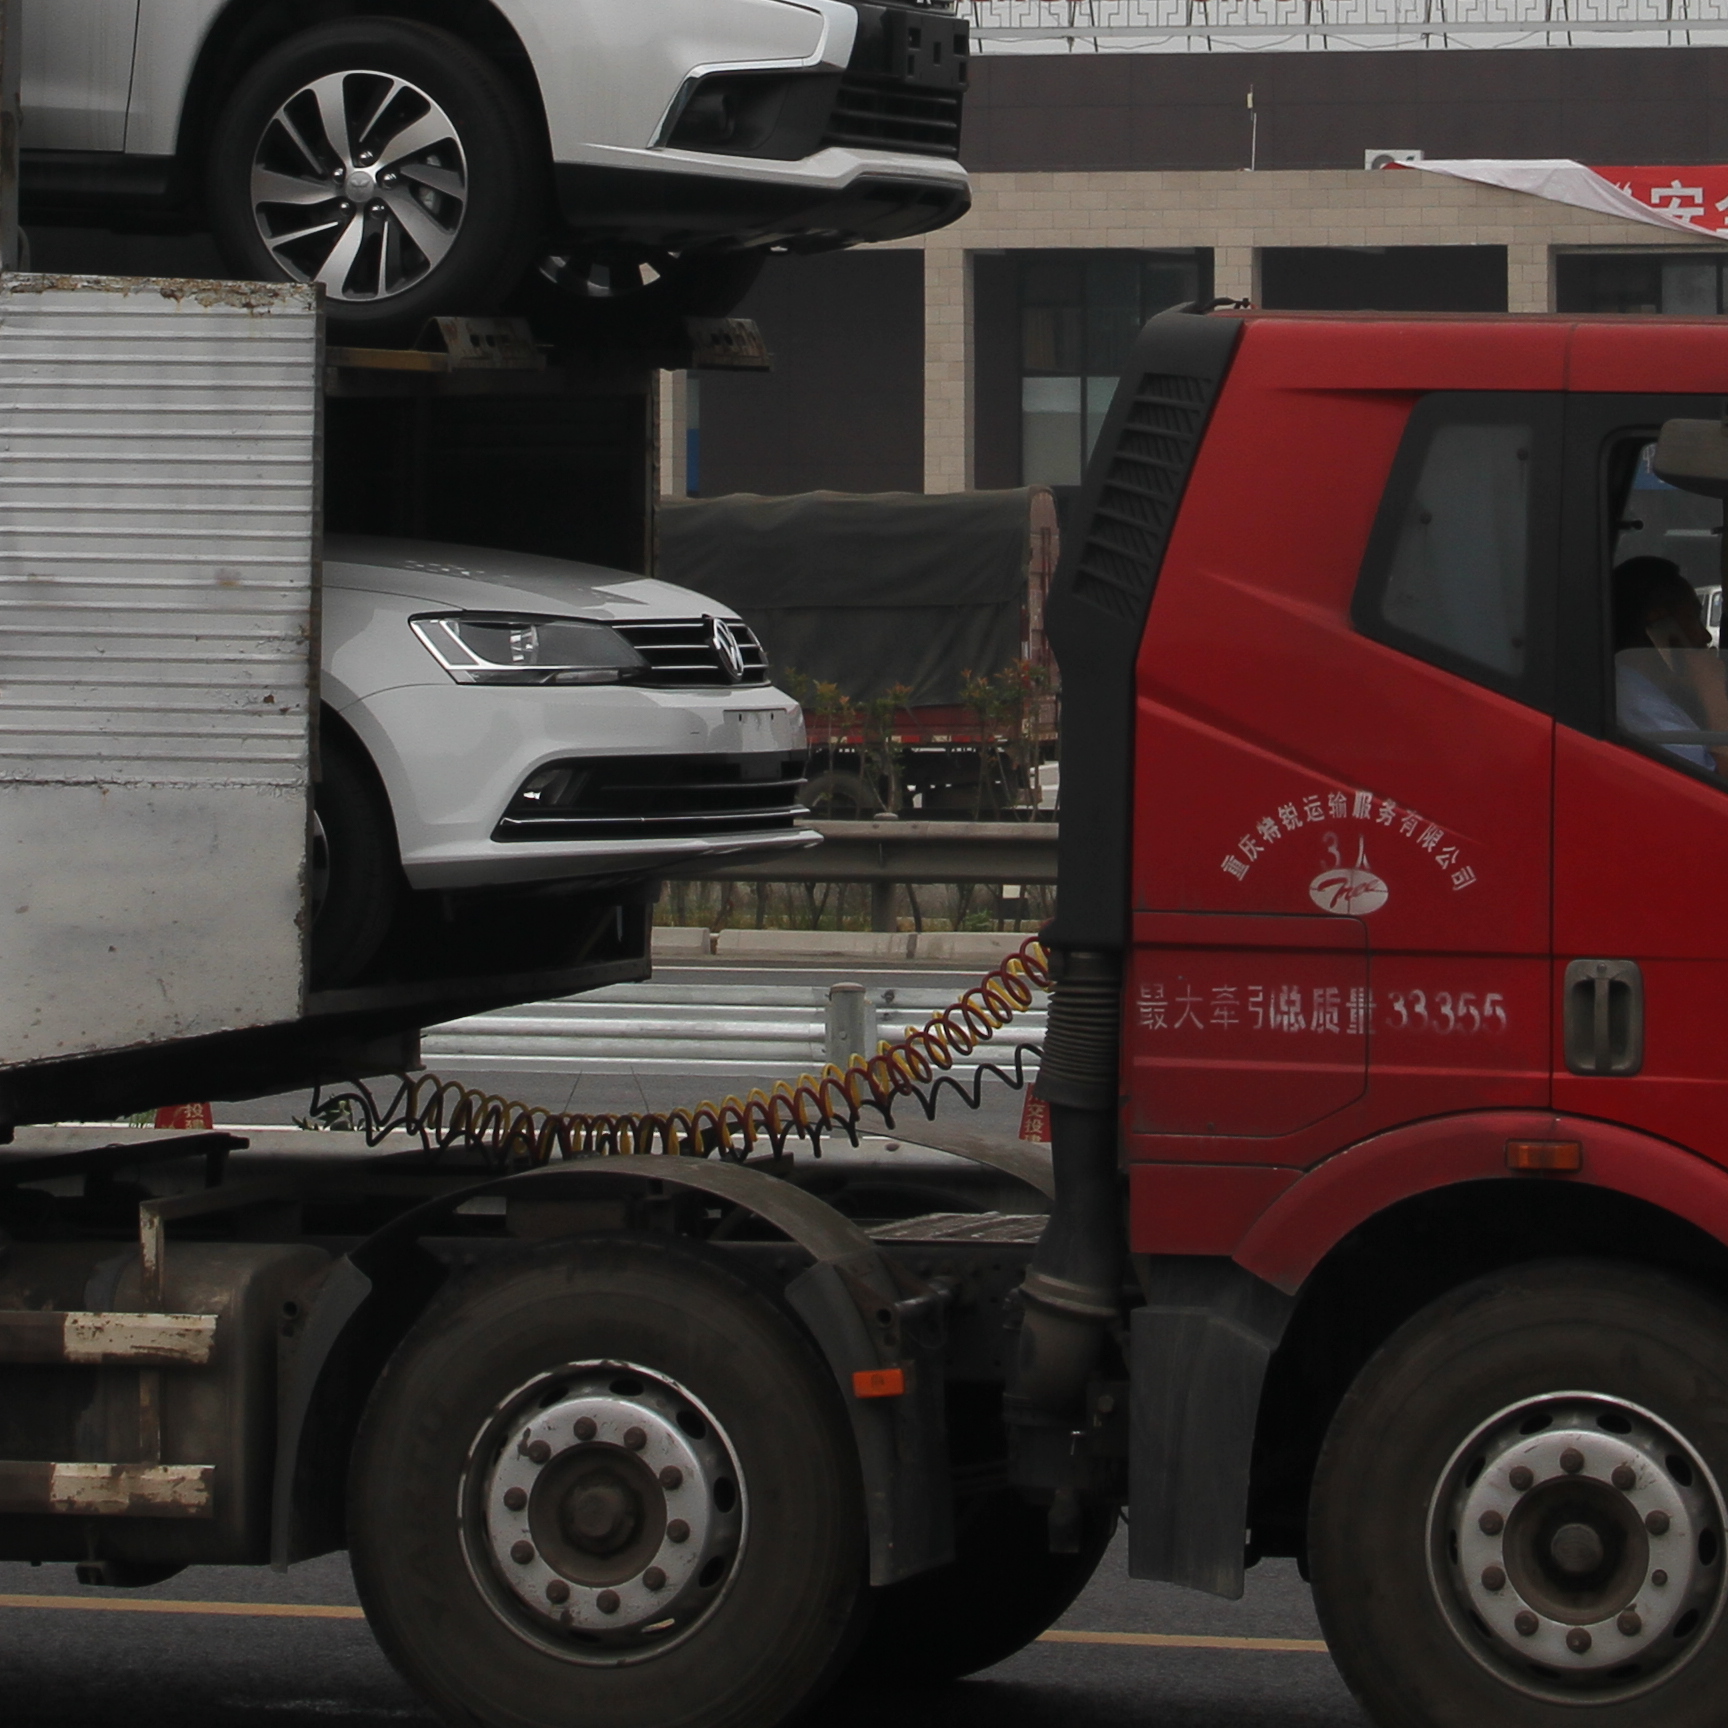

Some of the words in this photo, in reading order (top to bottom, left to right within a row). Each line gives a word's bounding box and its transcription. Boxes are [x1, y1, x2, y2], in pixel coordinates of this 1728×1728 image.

[1220, 790, 1477, 891] 重庆特锐运输服务有限公司
[1136, 982, 1377, 1035] 最大牵引总质量
